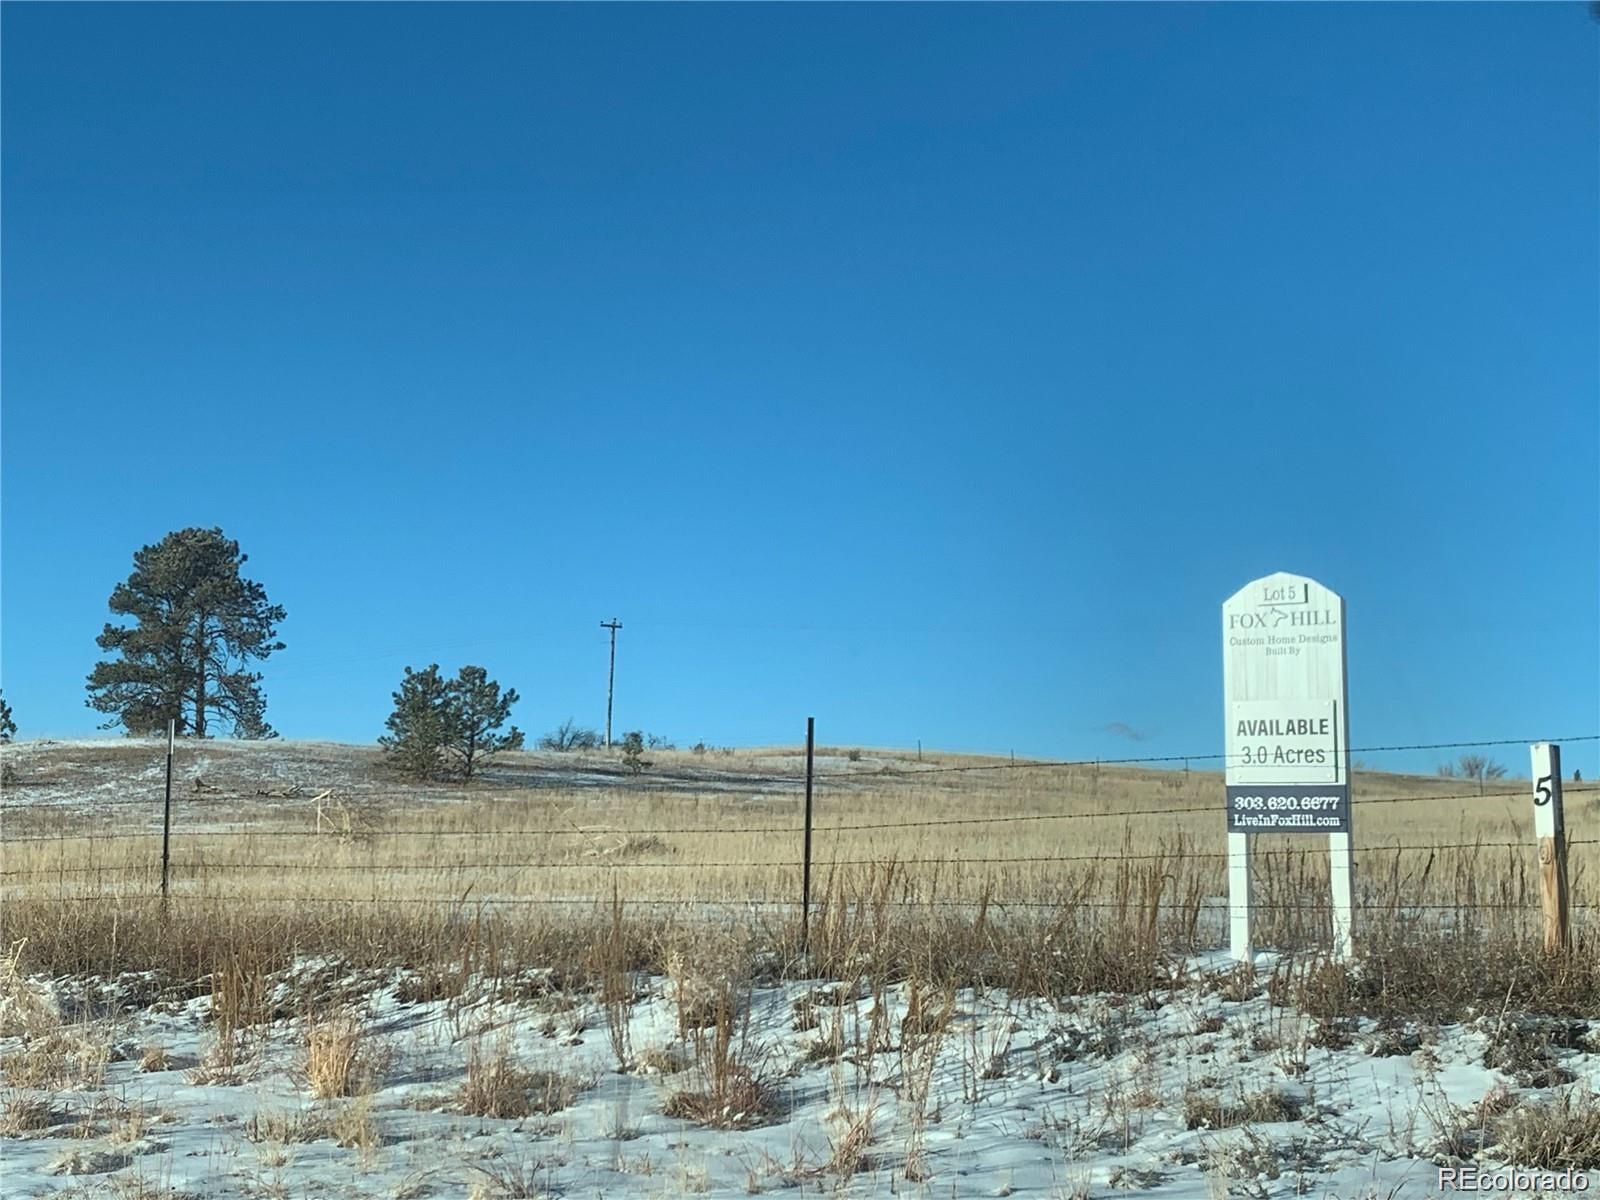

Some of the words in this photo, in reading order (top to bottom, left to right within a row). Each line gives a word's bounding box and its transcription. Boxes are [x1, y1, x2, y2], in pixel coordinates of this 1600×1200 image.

[1264, 587, 1285, 601] Lot
[1288, 586, 1296, 600] 5
[1229, 612, 1267, 629] FOX
[1291, 609, 1337, 626] HILL
[1229, 636, 1265, 646] Custom
[1268, 635, 1297, 645] Home
[1298, 634, 1338, 645] Designs
[1265, 647, 1288, 656] Built
[1289, 646, 1301, 657] By
[1236, 718, 1329, 736] AVAILABLE
[1241, 745, 1268, 764] 3.0
[1273, 745, 1326, 764] Acres
[1533, 774, 1552, 807] 5
[1234, 796, 1340, 810] 303.620.6677
[1233, 814, 1341, 827] LiveInFoxHill.com
